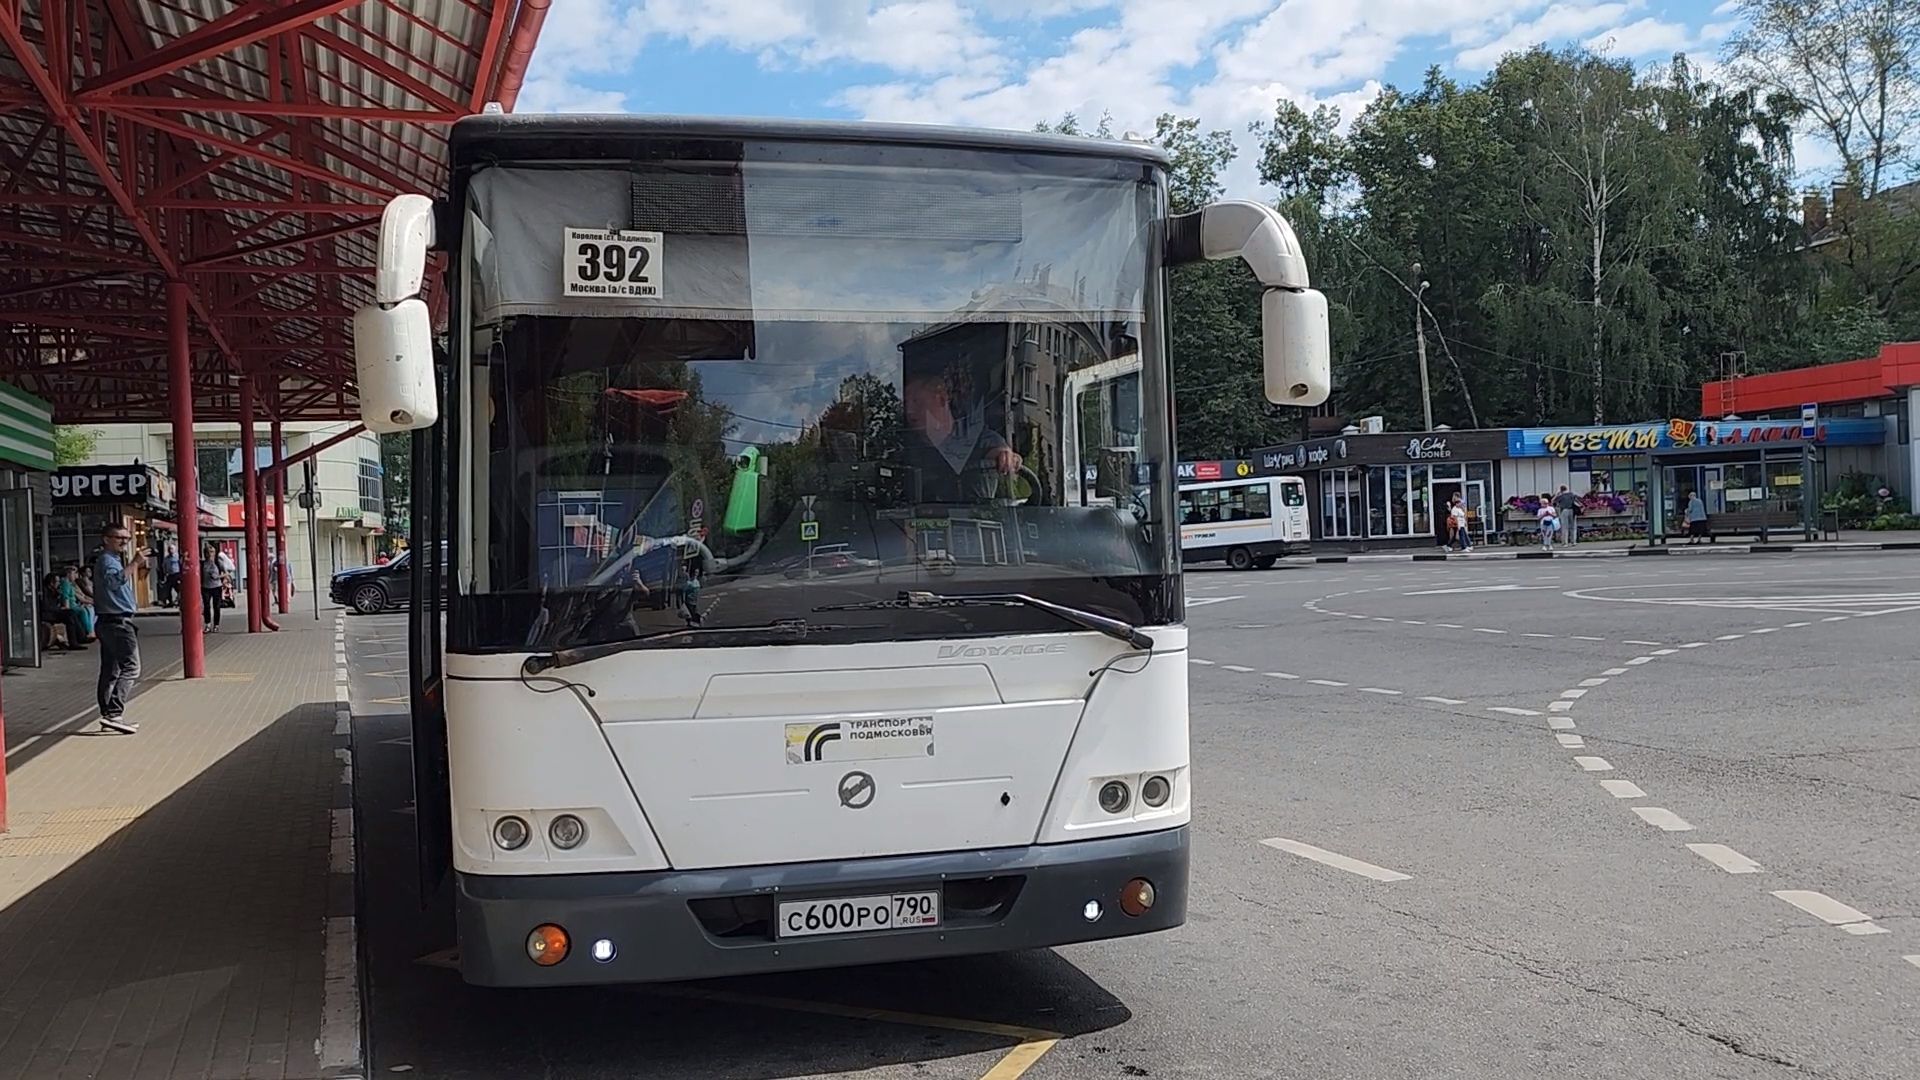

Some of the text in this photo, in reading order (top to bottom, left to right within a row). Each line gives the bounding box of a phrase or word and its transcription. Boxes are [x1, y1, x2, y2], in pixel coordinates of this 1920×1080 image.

[572, 232, 602, 240] Королев
[578, 243, 650, 282] 392
[570, 283, 657, 296] Москва (а/с ВДНХ)
[1544, 428, 1660, 458] ЦВЕТЫ
[1421, 450, 1451, 459] DONER
[850, 718, 913, 729] ТРАНСПОРТ
[849, 728, 932, 740] ПОДМОСКОВЬЯ
[894, 896, 932, 917] 790
[903, 916, 921, 924] RUS
